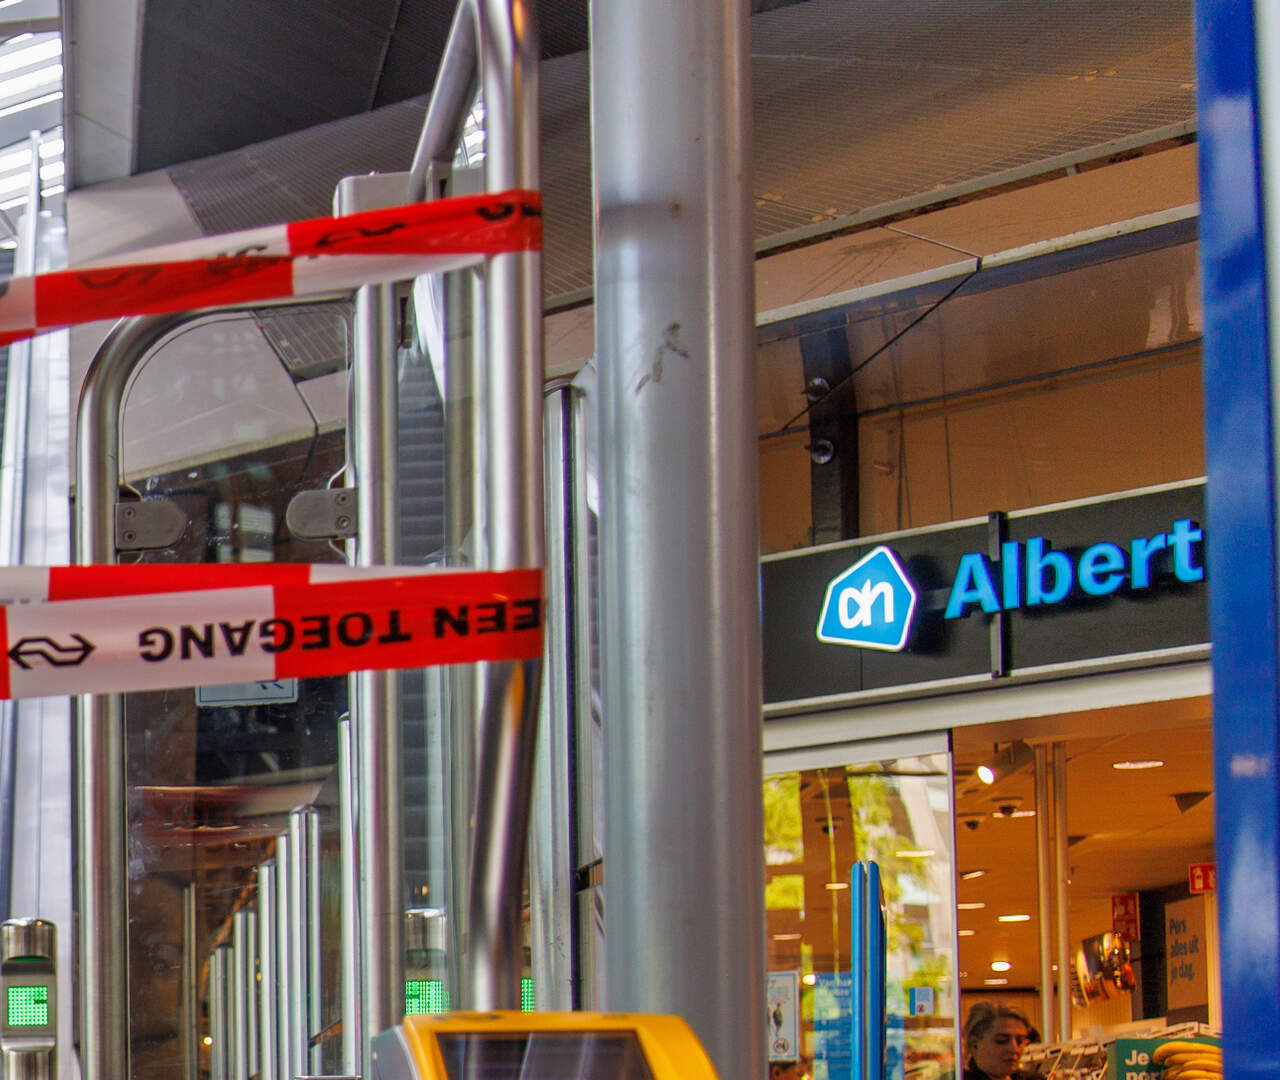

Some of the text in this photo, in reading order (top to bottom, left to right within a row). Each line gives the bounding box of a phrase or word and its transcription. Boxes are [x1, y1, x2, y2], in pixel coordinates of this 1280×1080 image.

[944, 519, 1204, 619] Albert
[138, 597, 540, 662] EEN TOEGANG
[1125, 1049, 1149, 1066] Je
